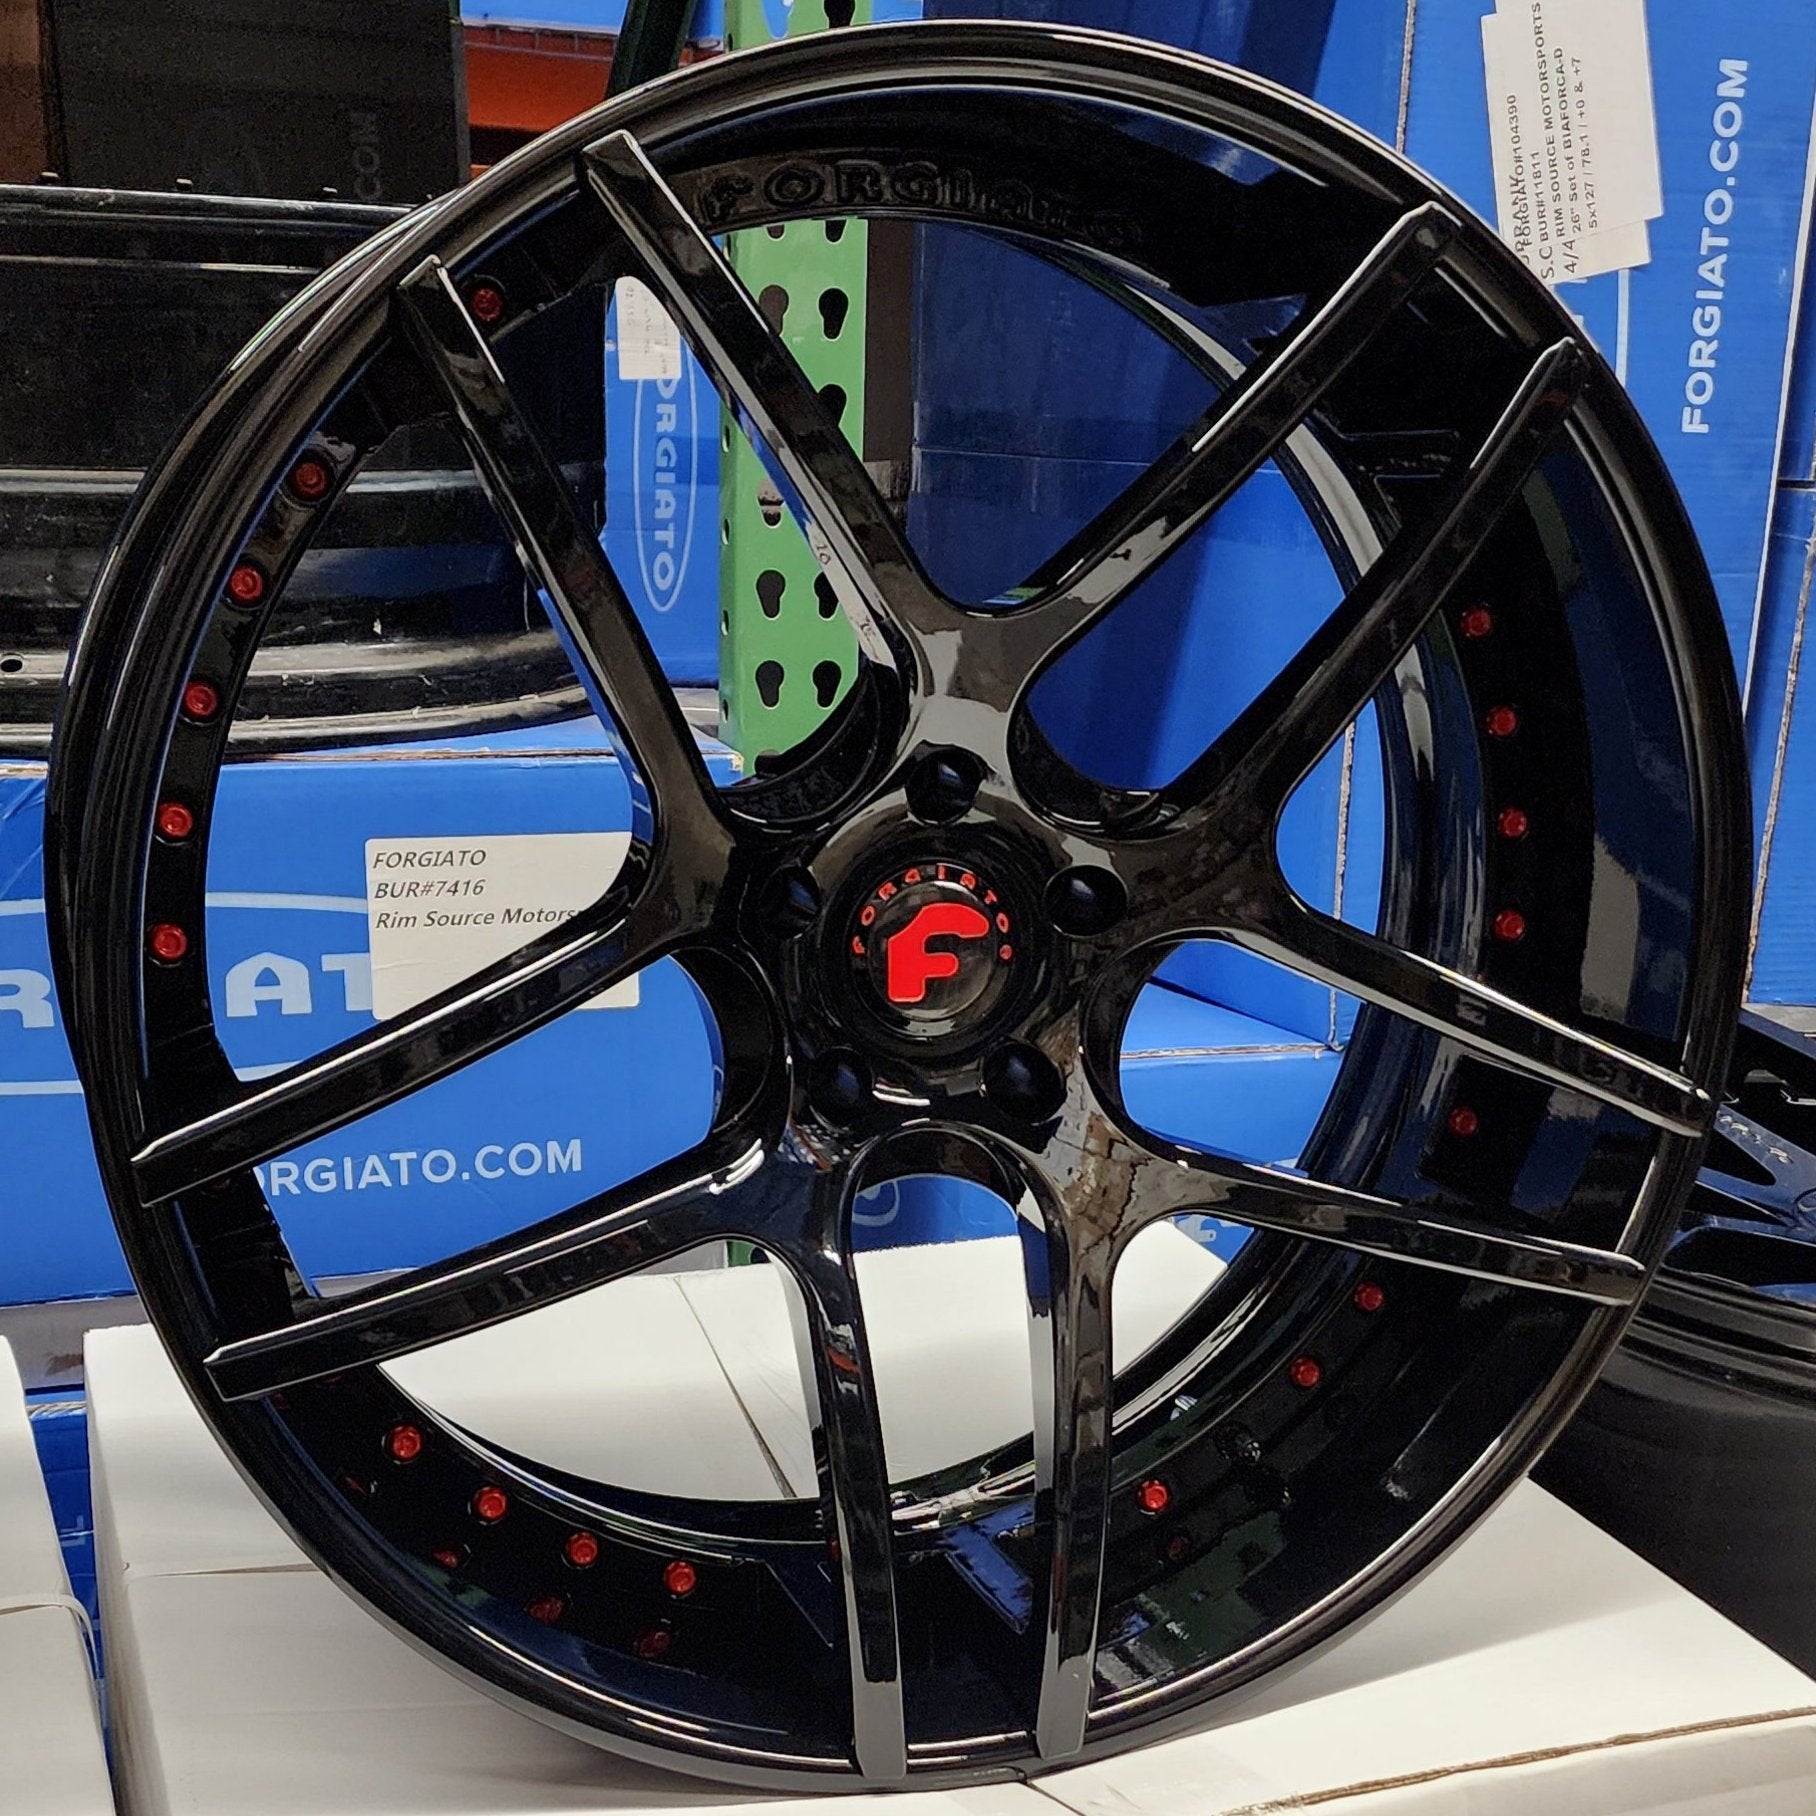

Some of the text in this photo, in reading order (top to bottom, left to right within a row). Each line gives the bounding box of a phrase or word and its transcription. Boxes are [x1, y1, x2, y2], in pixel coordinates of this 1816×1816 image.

[1571, 56, 1583, 76] +7
[1552, 47, 1573, 149] BIAFORCA-D
[1573, 81, 1584, 93] &
[1531, 2, 1567, 238] RIM SOURCE MOTORSPORTS
[1574, 99, 1587, 119] +0
[1563, 154, 1575, 171] of
[1580, 132, 1592, 167] 78.1
[1530, 150, 1549, 243] BUR#11811
[1567, 174, 1579, 203] Set
[1584, 181, 1599, 229] 5x127
[1562, 239, 1580, 274] 4/4
[1681, 58, 1750, 435] FORGIATO.COM
[372, 849, 487, 870] FORGIATO
[374, 879, 486, 900] BUR#7416
[376, 912, 417, 929] Rim
[423, 910, 495, 927] Source
[887, 901, 990, 1003] F
